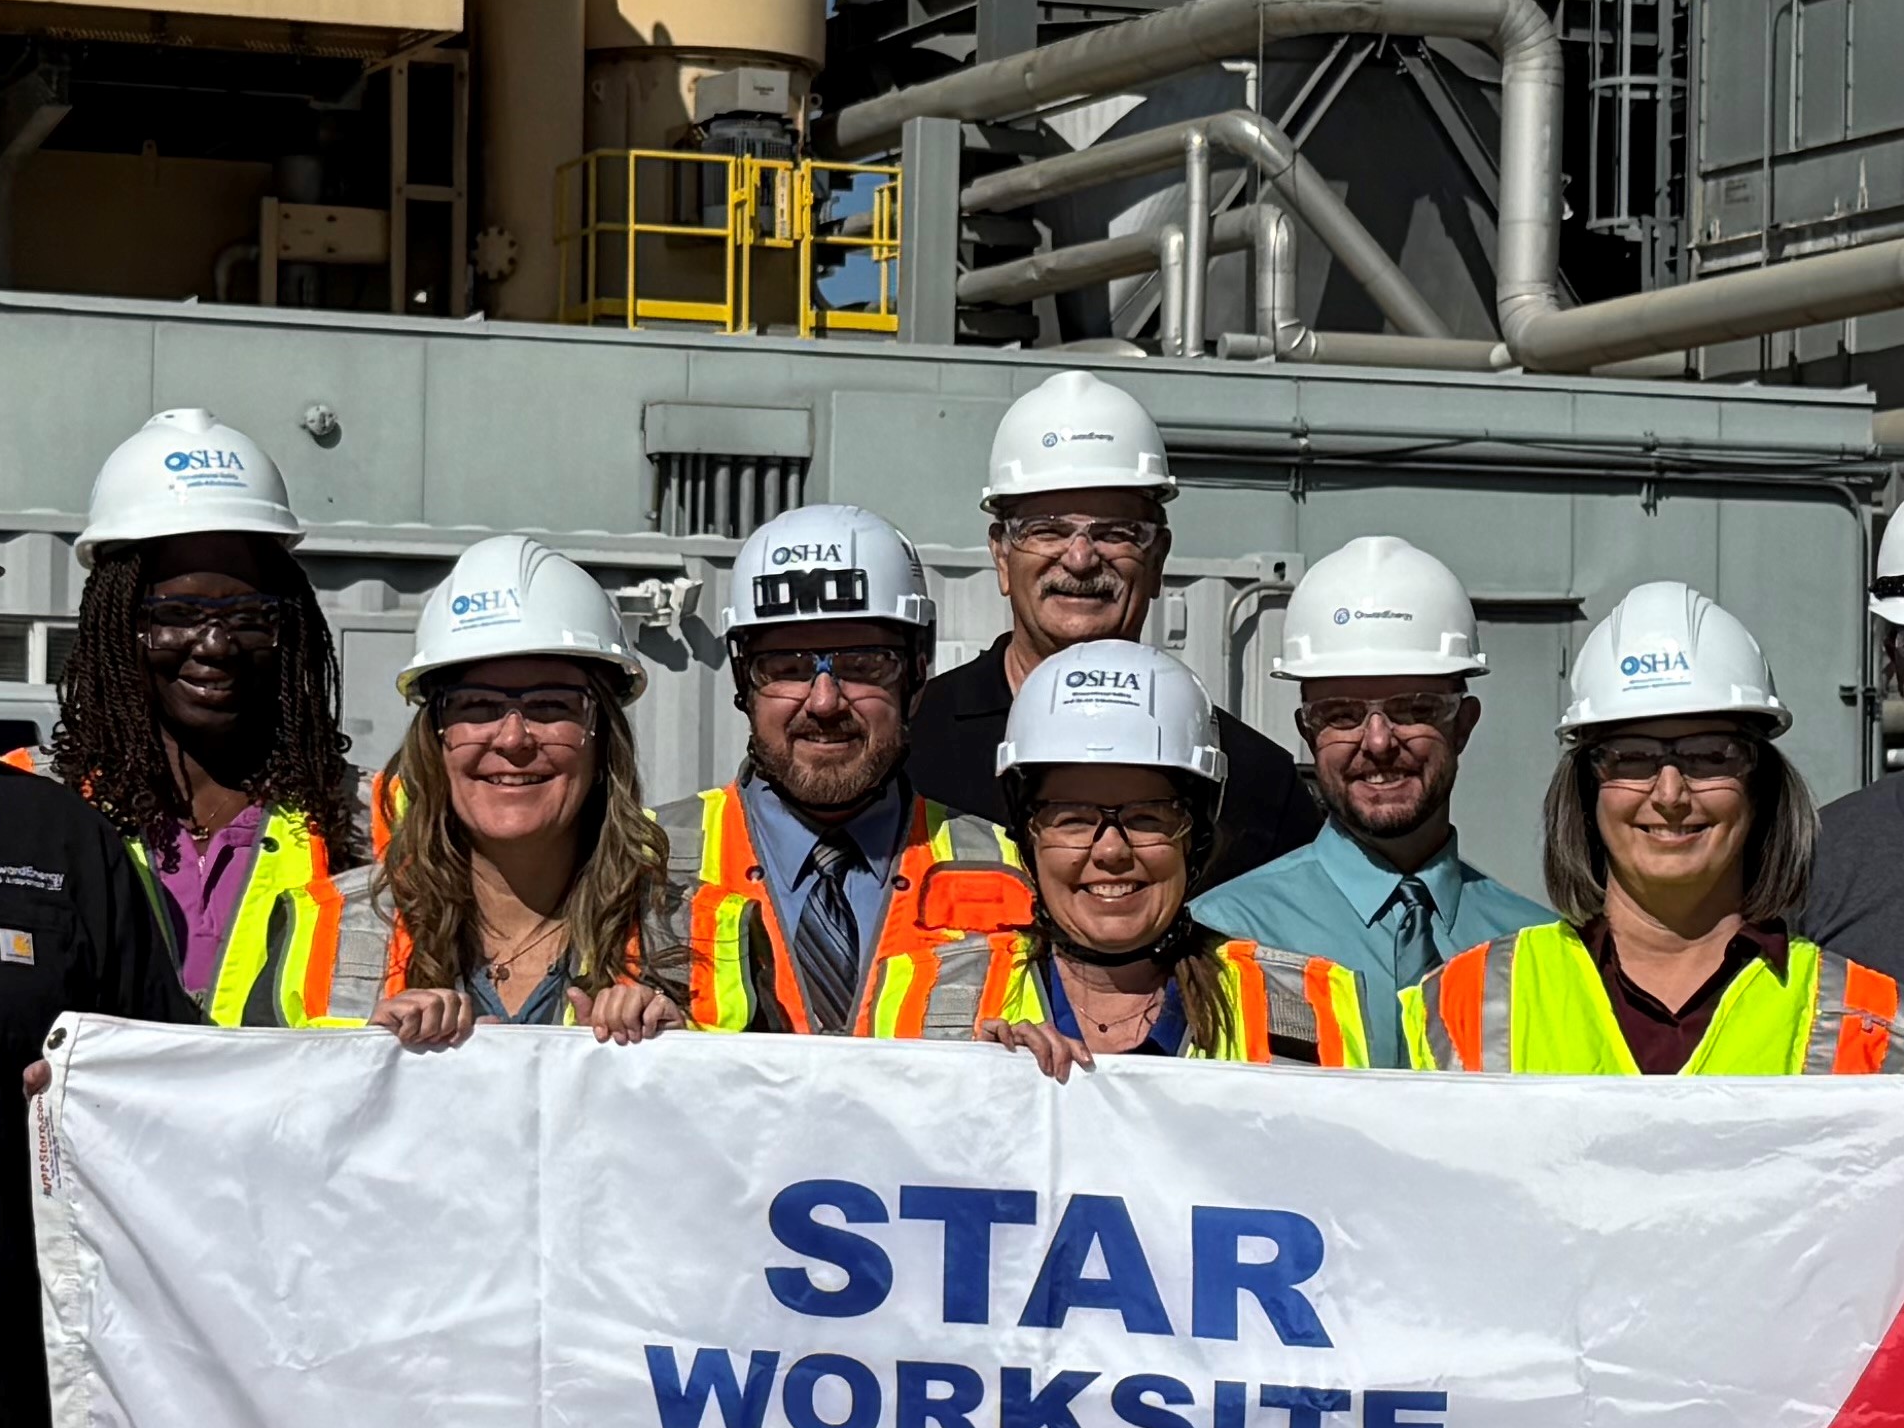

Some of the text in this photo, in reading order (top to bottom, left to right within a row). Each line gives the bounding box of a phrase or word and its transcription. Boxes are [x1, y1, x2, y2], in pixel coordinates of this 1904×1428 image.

[164, 449, 245, 472] OSHA
[771, 543, 842, 566] OSHA
[451, 588, 520, 615] OSHA
[1620, 651, 1690, 676] OSHA
[1065, 669, 1141, 690] OSHA
[764, 1178, 1335, 1349] STAR
